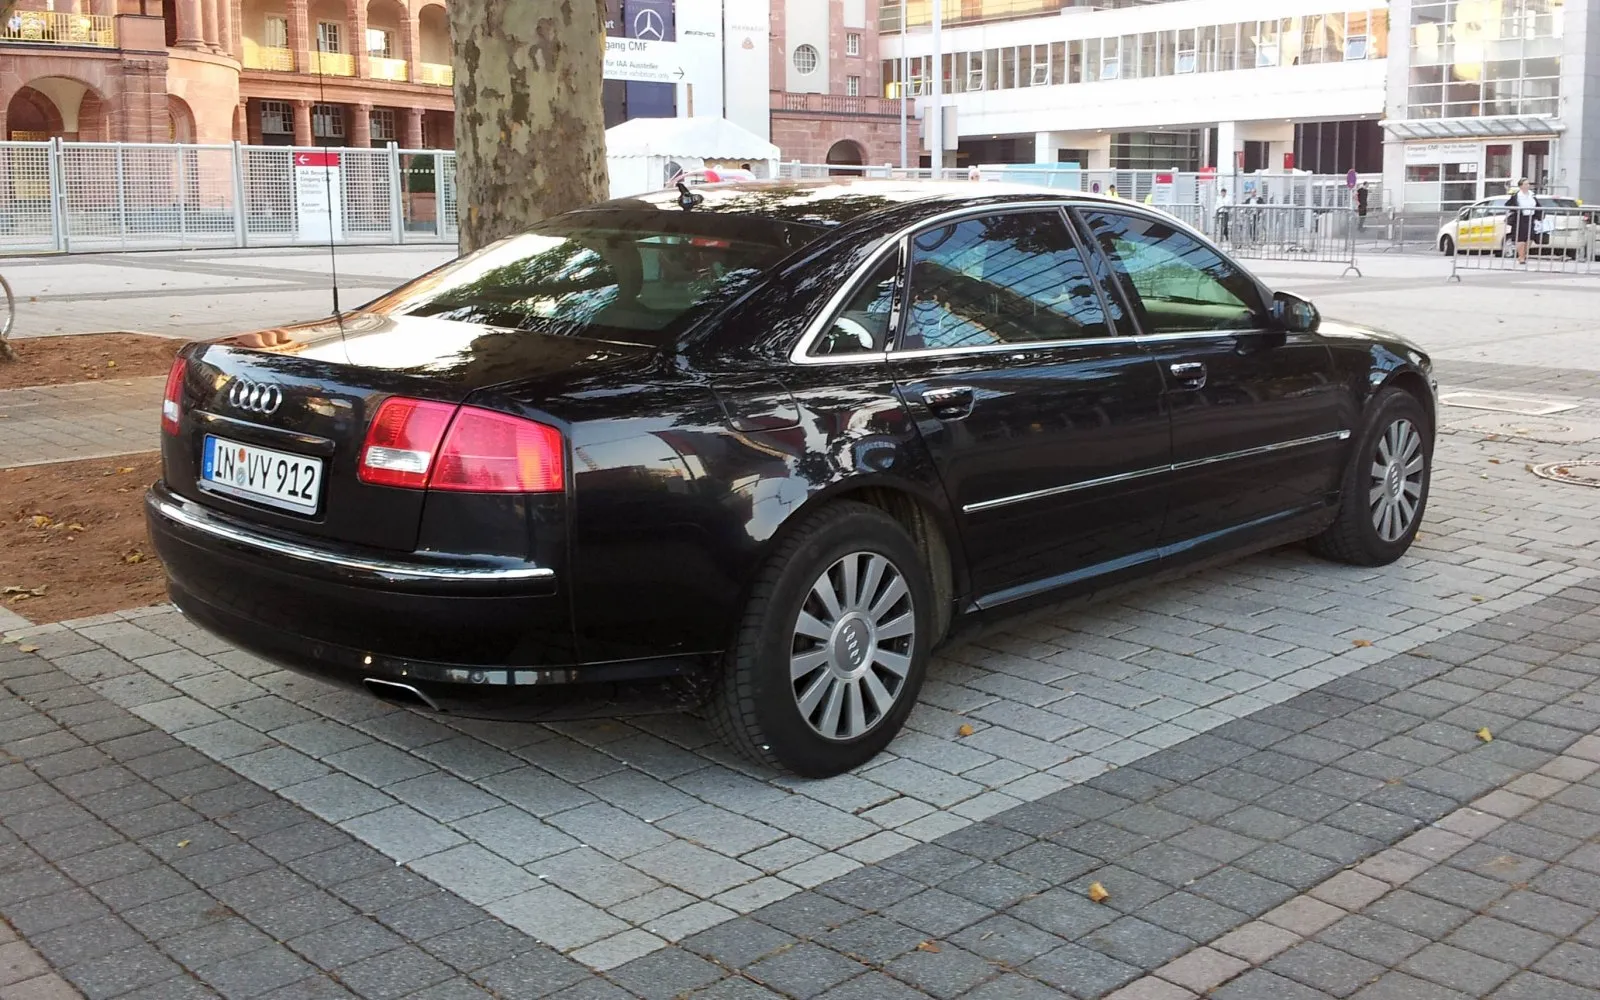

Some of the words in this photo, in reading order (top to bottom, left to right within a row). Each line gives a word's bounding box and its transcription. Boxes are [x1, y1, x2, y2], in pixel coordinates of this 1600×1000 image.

[628, 41, 648, 52] CMF
[215, 445, 236, 481] IN
[248, 453, 273, 489] VY
[277, 460, 316, 501] 912
